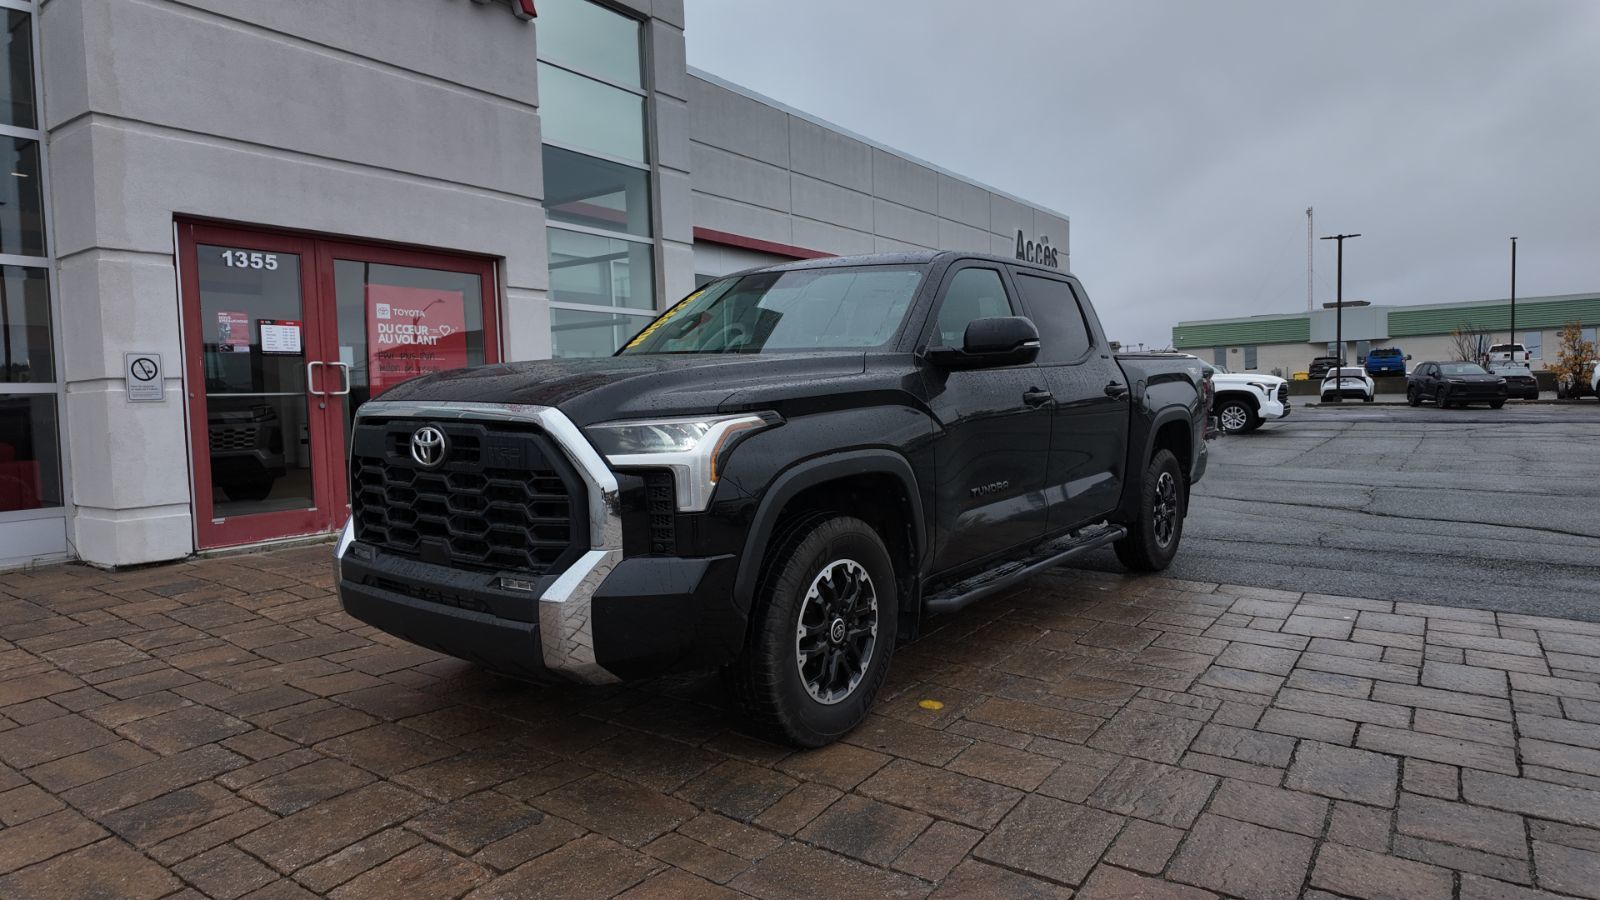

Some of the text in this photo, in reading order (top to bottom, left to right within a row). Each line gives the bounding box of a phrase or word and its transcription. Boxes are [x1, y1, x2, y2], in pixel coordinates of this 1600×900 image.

[222, 250, 278, 270] 1355
[392, 308, 425, 318] TOYOTA
[377, 323, 394, 334] DU
[378, 334, 438, 346] AU VOLANT
